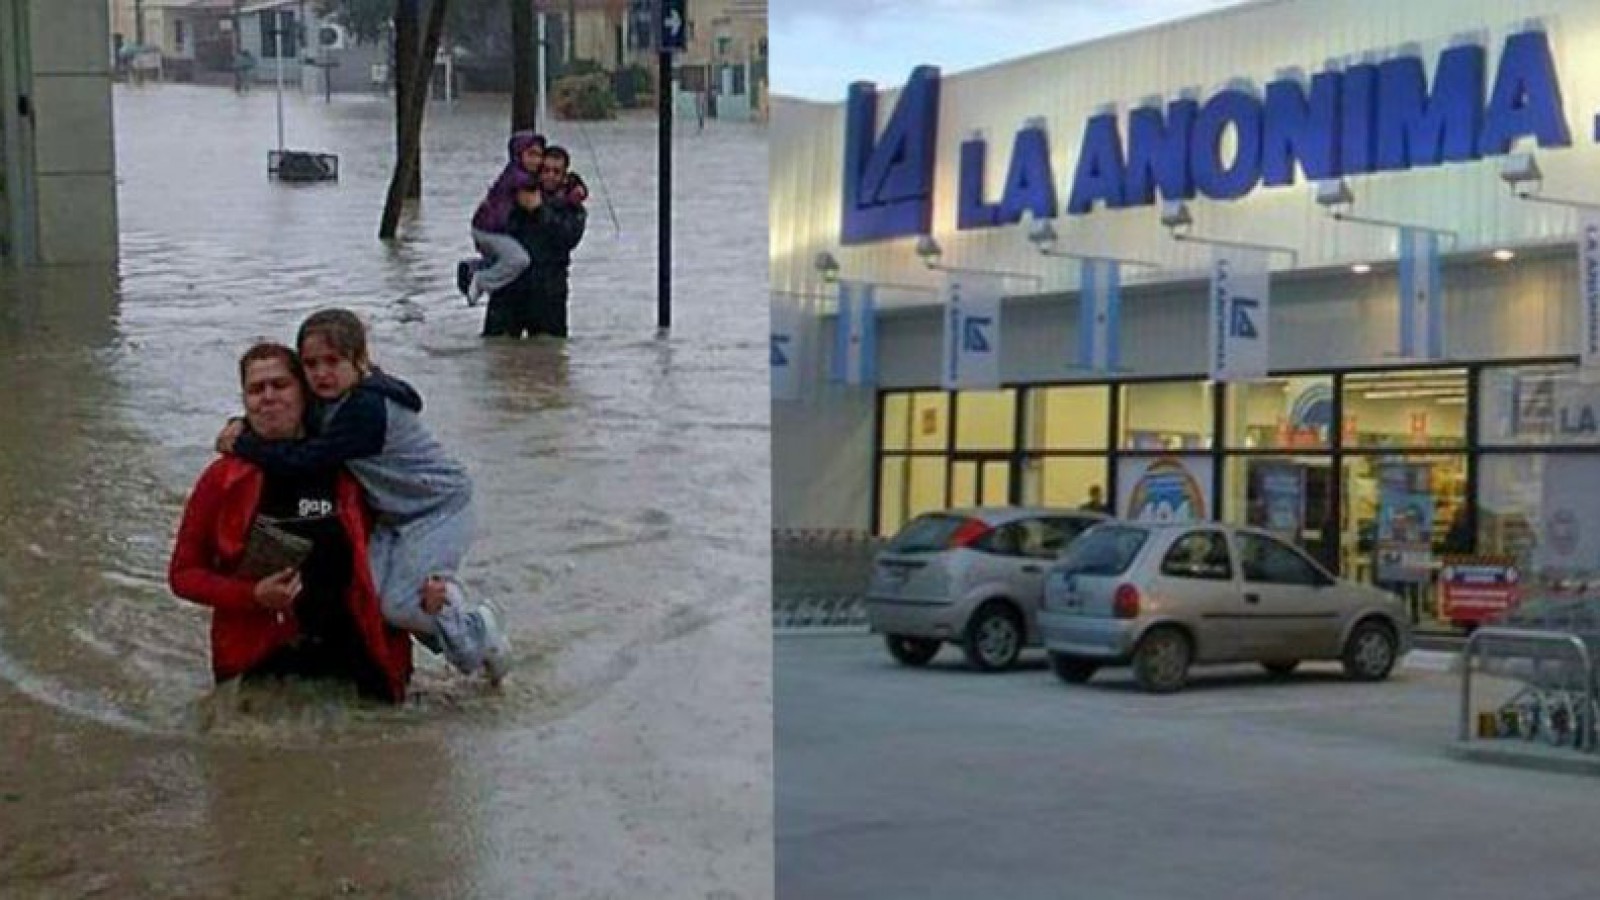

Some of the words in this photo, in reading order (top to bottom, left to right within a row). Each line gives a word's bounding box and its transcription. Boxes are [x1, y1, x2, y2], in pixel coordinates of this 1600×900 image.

[957, 125, 1058, 231] LA
[1067, 30, 1573, 214] ANONIMA
[299, 498, 333, 517] gap
